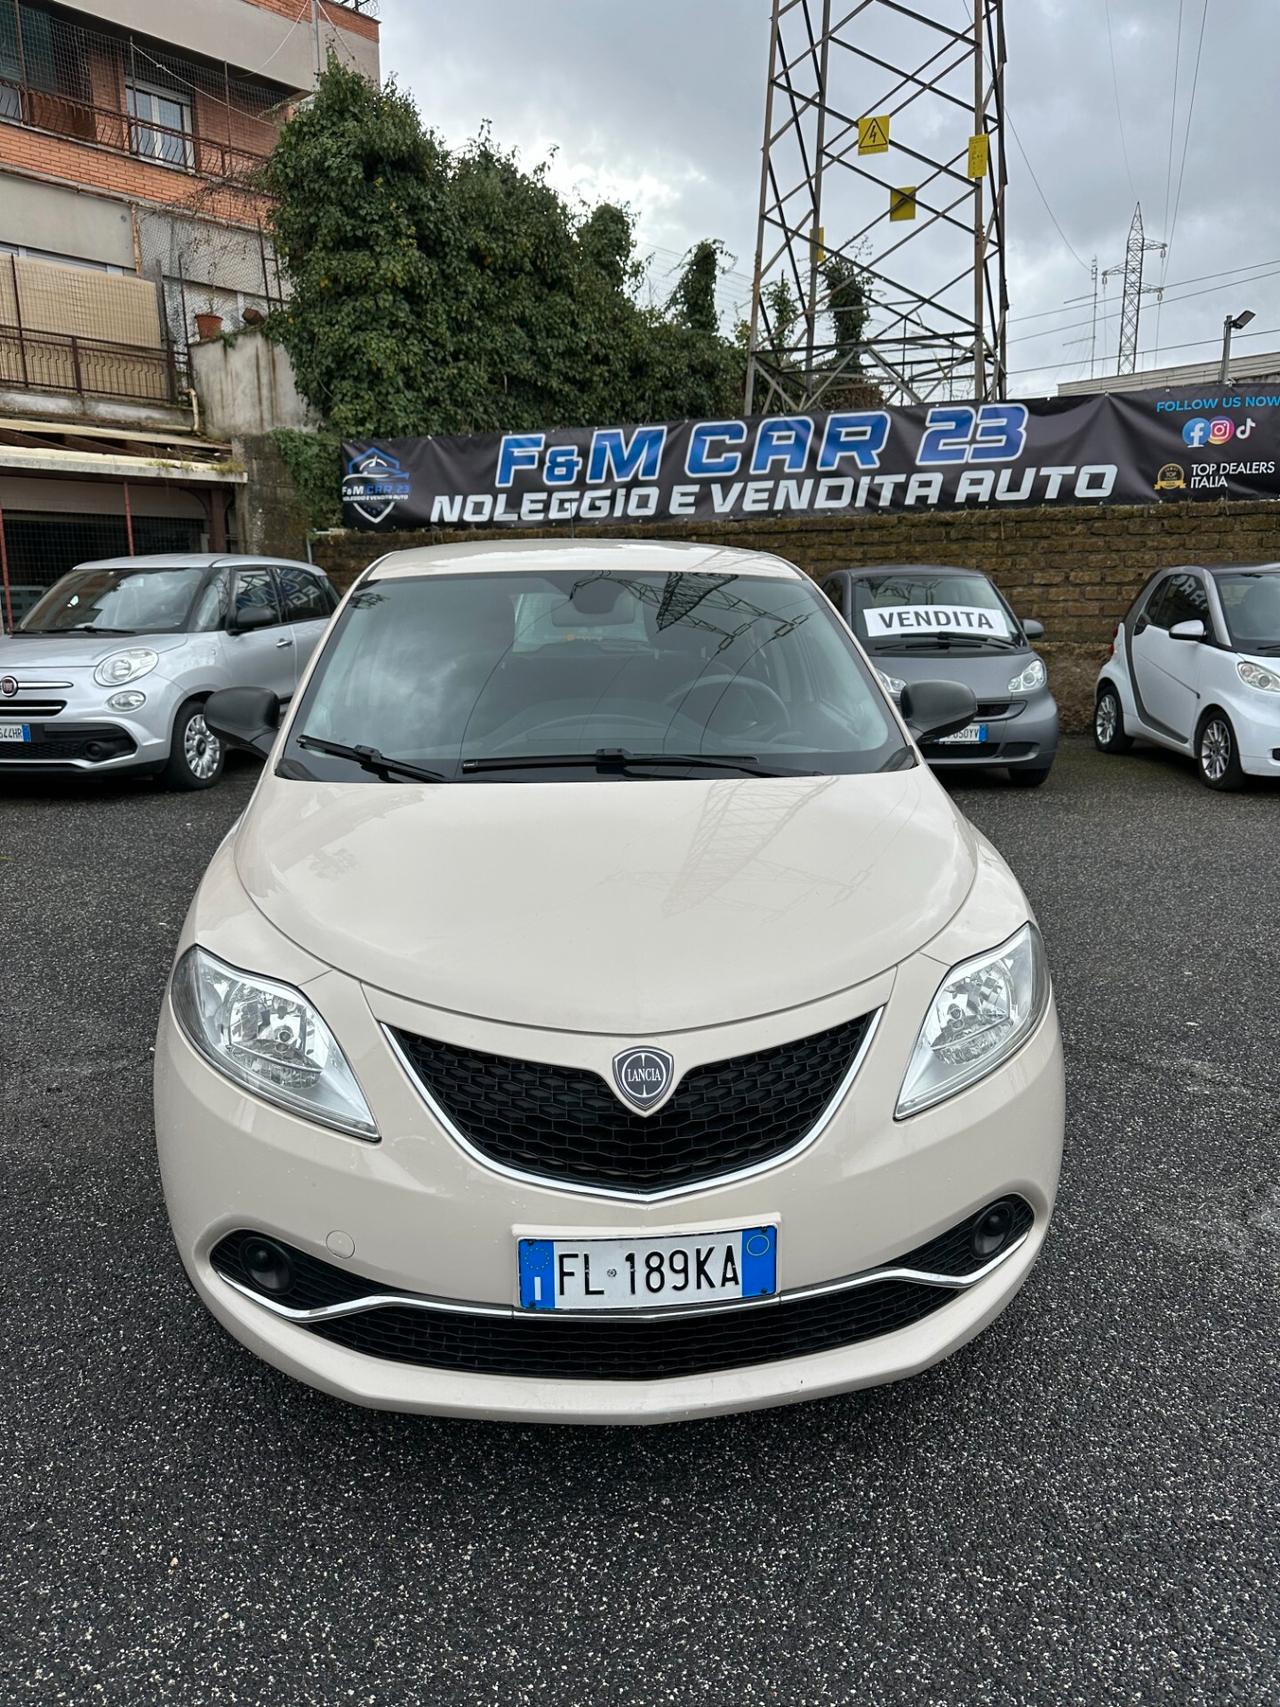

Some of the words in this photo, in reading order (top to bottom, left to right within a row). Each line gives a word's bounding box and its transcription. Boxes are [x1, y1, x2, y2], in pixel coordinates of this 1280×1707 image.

[1156, 398, 1218, 413] FOLLOW
[1222, 396, 1241, 408] US
[1245, 395, 1280, 408] NOW
[495, 426, 667, 487] F&M
[685, 411, 891, 477] CAR
[915, 402, 1029, 466] 23
[1191, 463, 1217, 476] TOP
[1219, 461, 1276, 475] DEALERS
[1190, 476, 1228, 489] ITALIA
[430, 488, 660, 523] NOLEGGIO
[668, 485, 700, 515] E
[711, 471, 944, 515] VENDITA
[954, 464, 1118, 503] AUTO
[879, 610, 994, 629] VENDITA
[627, 1067, 661, 1082] LANCIA
[558, 1253, 605, 1296] FL
[625, 1244, 740, 1296] 189KA
